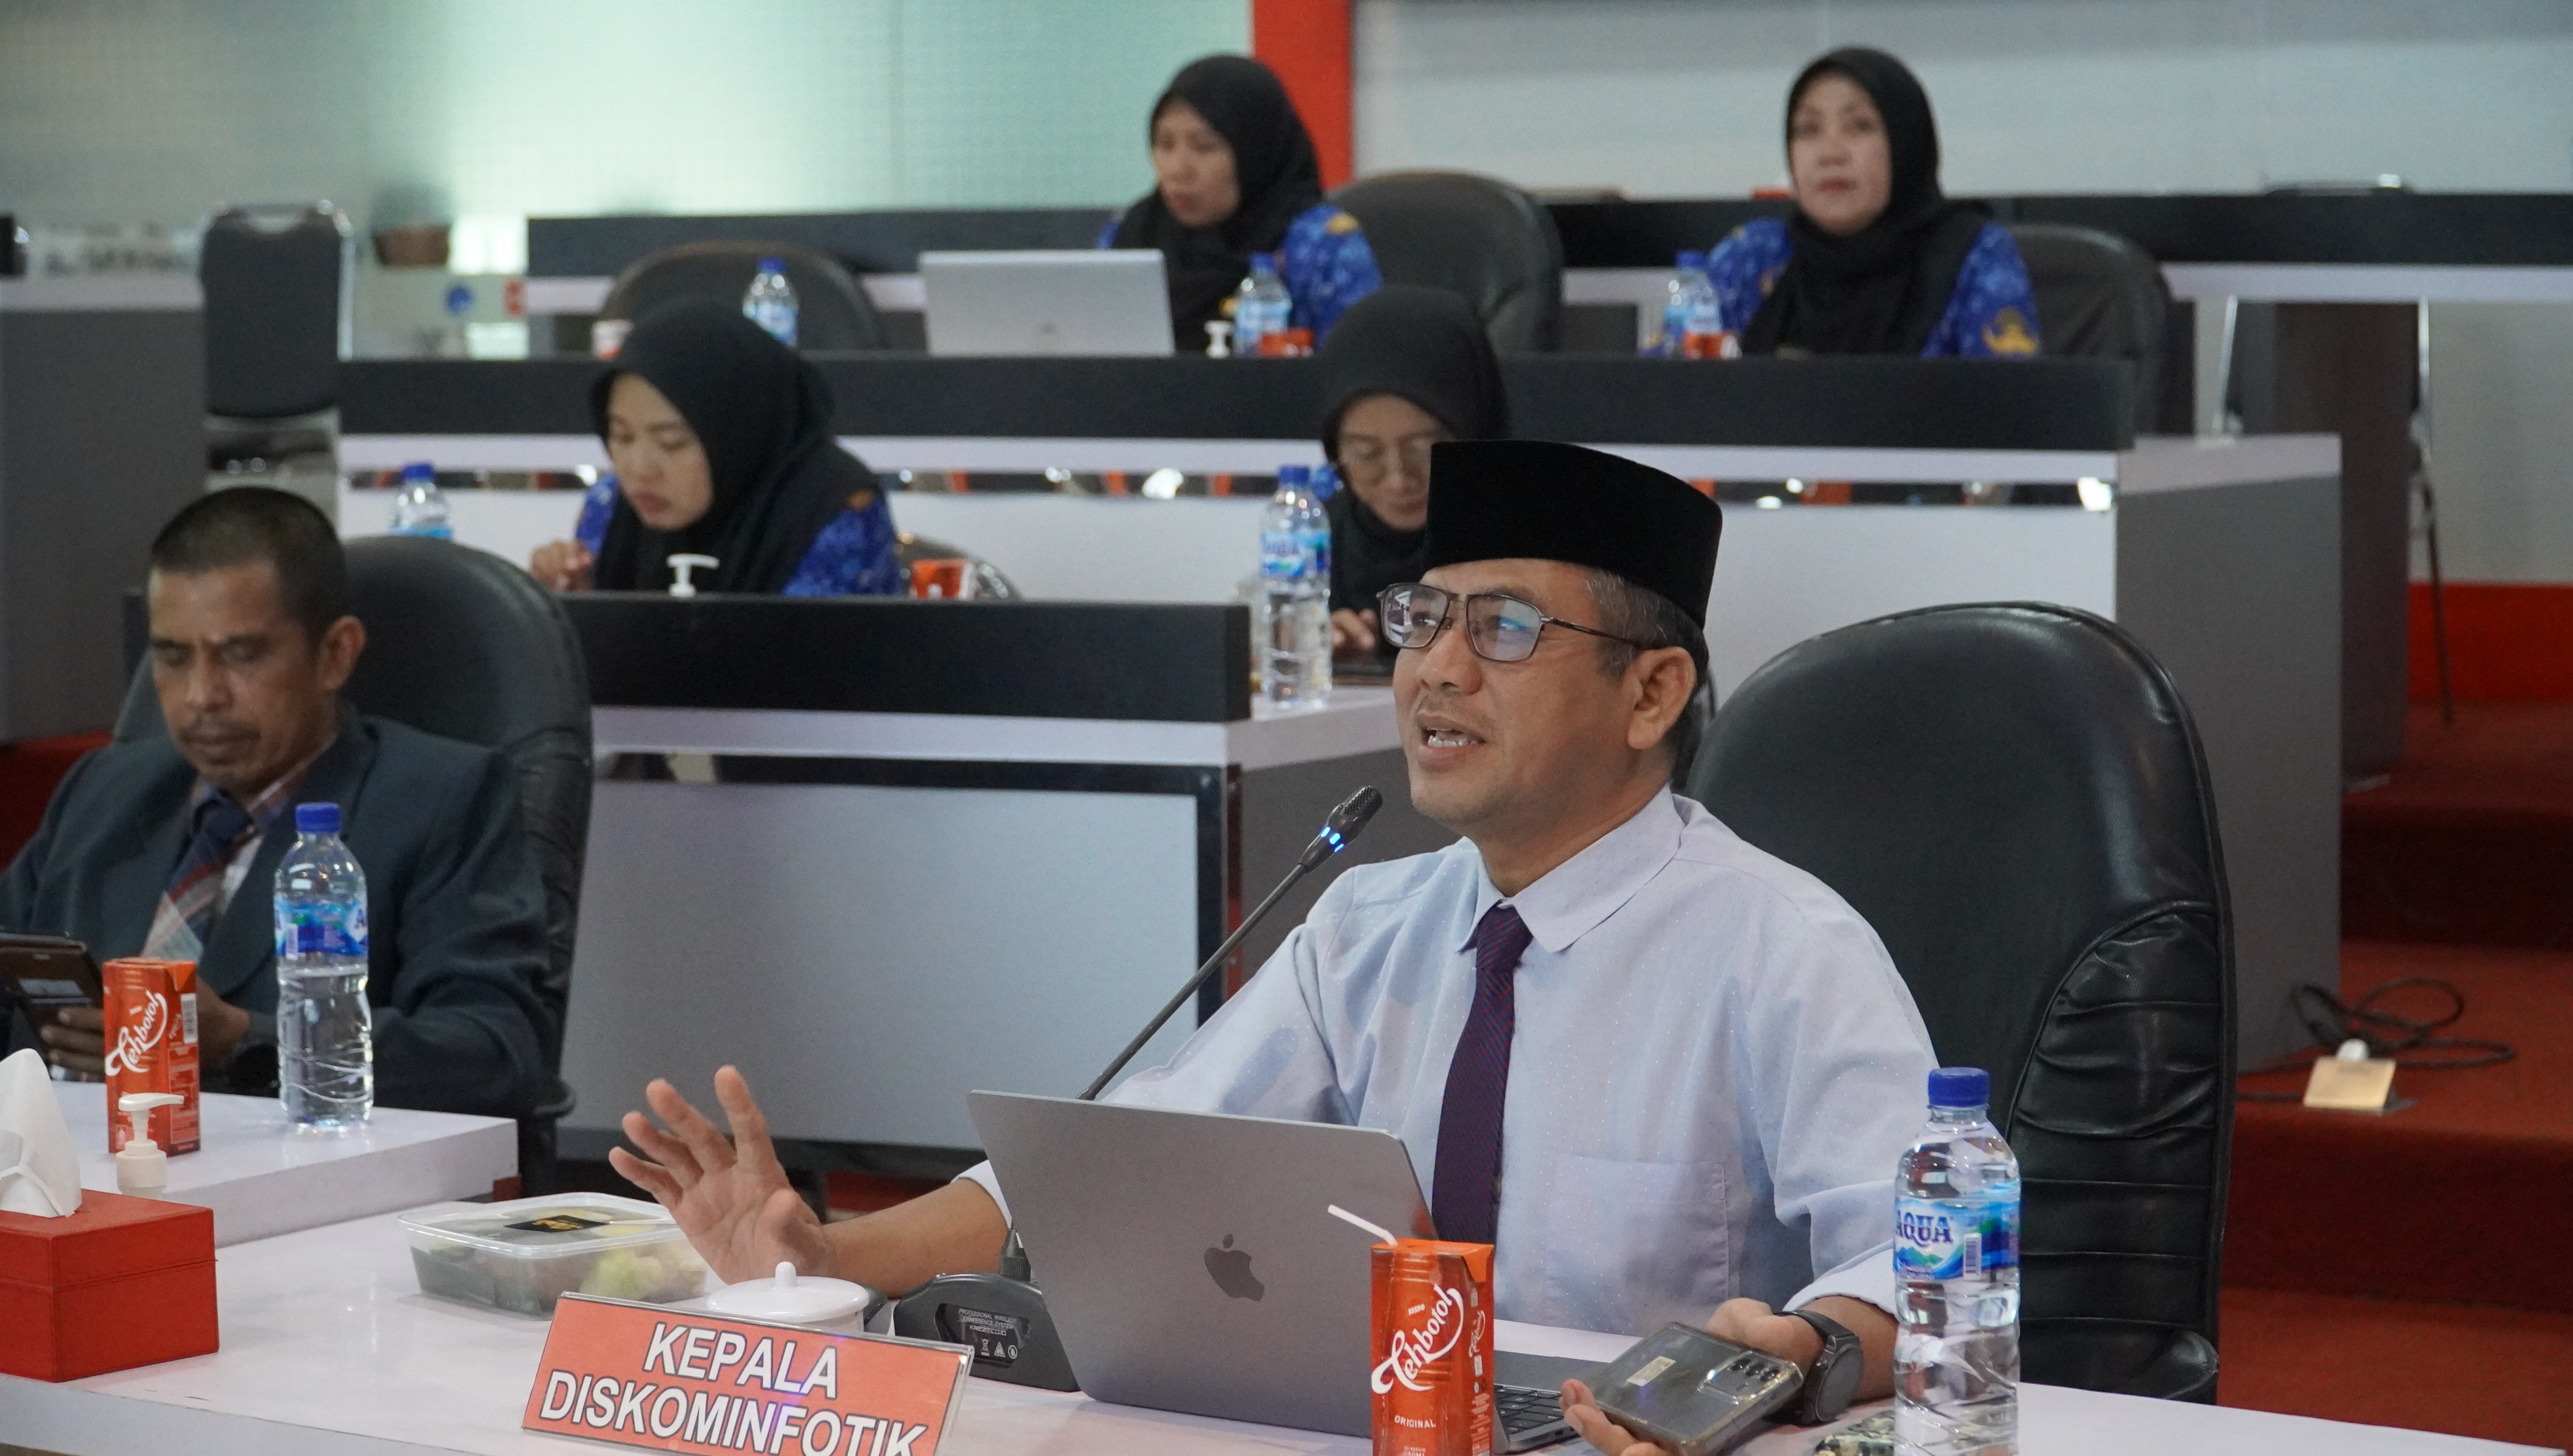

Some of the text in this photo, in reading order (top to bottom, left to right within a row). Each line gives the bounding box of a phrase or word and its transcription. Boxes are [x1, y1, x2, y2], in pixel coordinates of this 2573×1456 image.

[958, 1308, 1018, 1324] PROFESSIONAL WIRELESS
[962, 1316, 1013, 1329] CONFERENCE SYSTEM
[1371, 1282, 1464, 1395] Tehbotol
[644, 1322, 839, 1399] KEPALA
[539, 1370, 928, 1456] DISKOMINFOTIK
[1395, 1414, 1436, 1429] ORIGINAL
